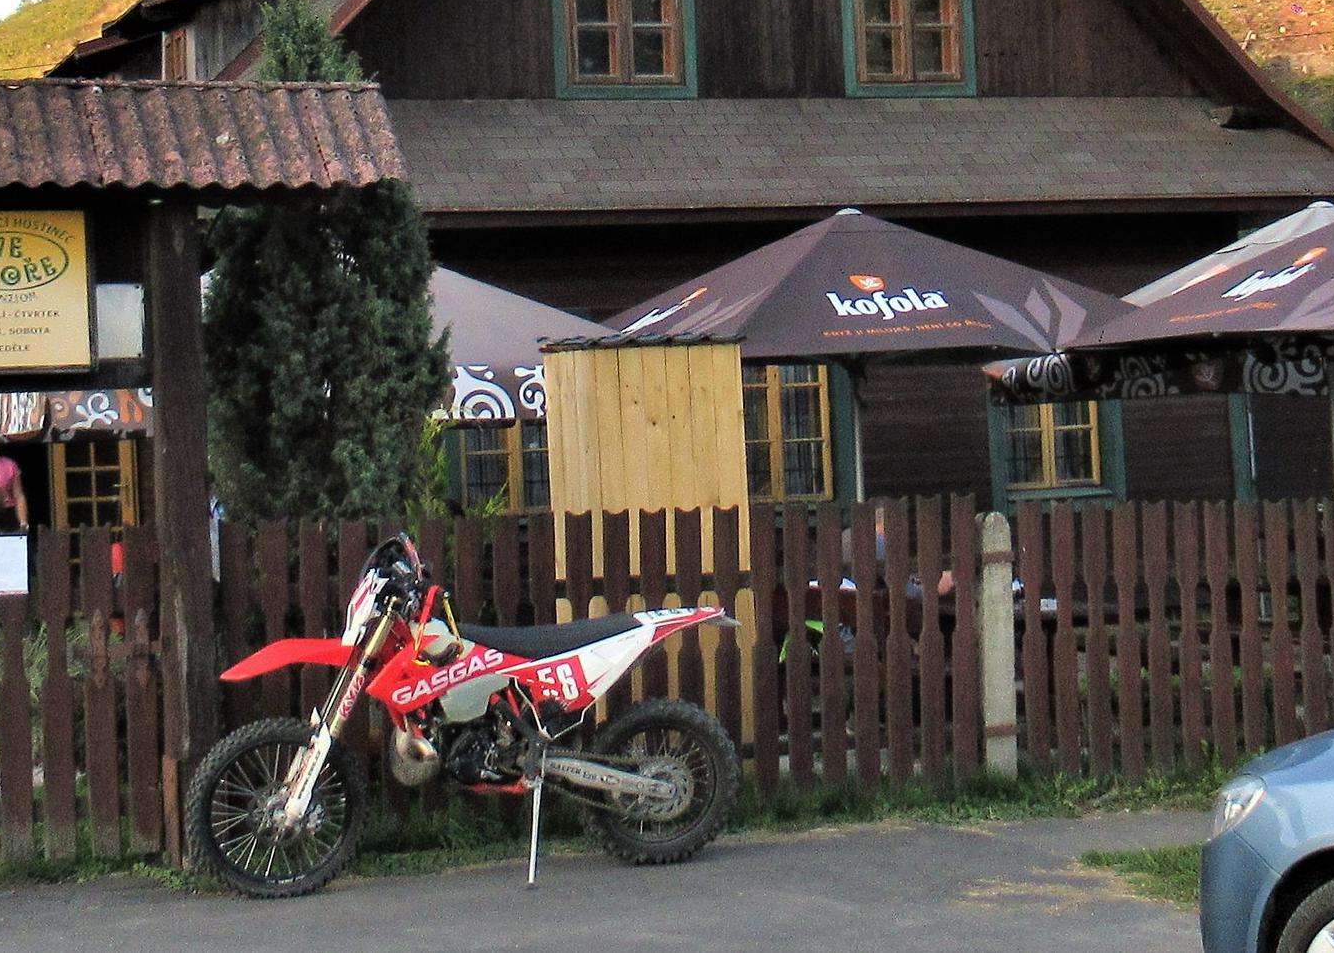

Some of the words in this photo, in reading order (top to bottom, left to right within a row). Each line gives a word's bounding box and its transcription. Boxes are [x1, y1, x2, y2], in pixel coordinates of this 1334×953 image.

[14, 218, 75, 244] HOSTINEC
[826, 287, 949, 320] kofola
[391, 648, 504, 706] GASGAS
[537, 663, 579, 700] 56
